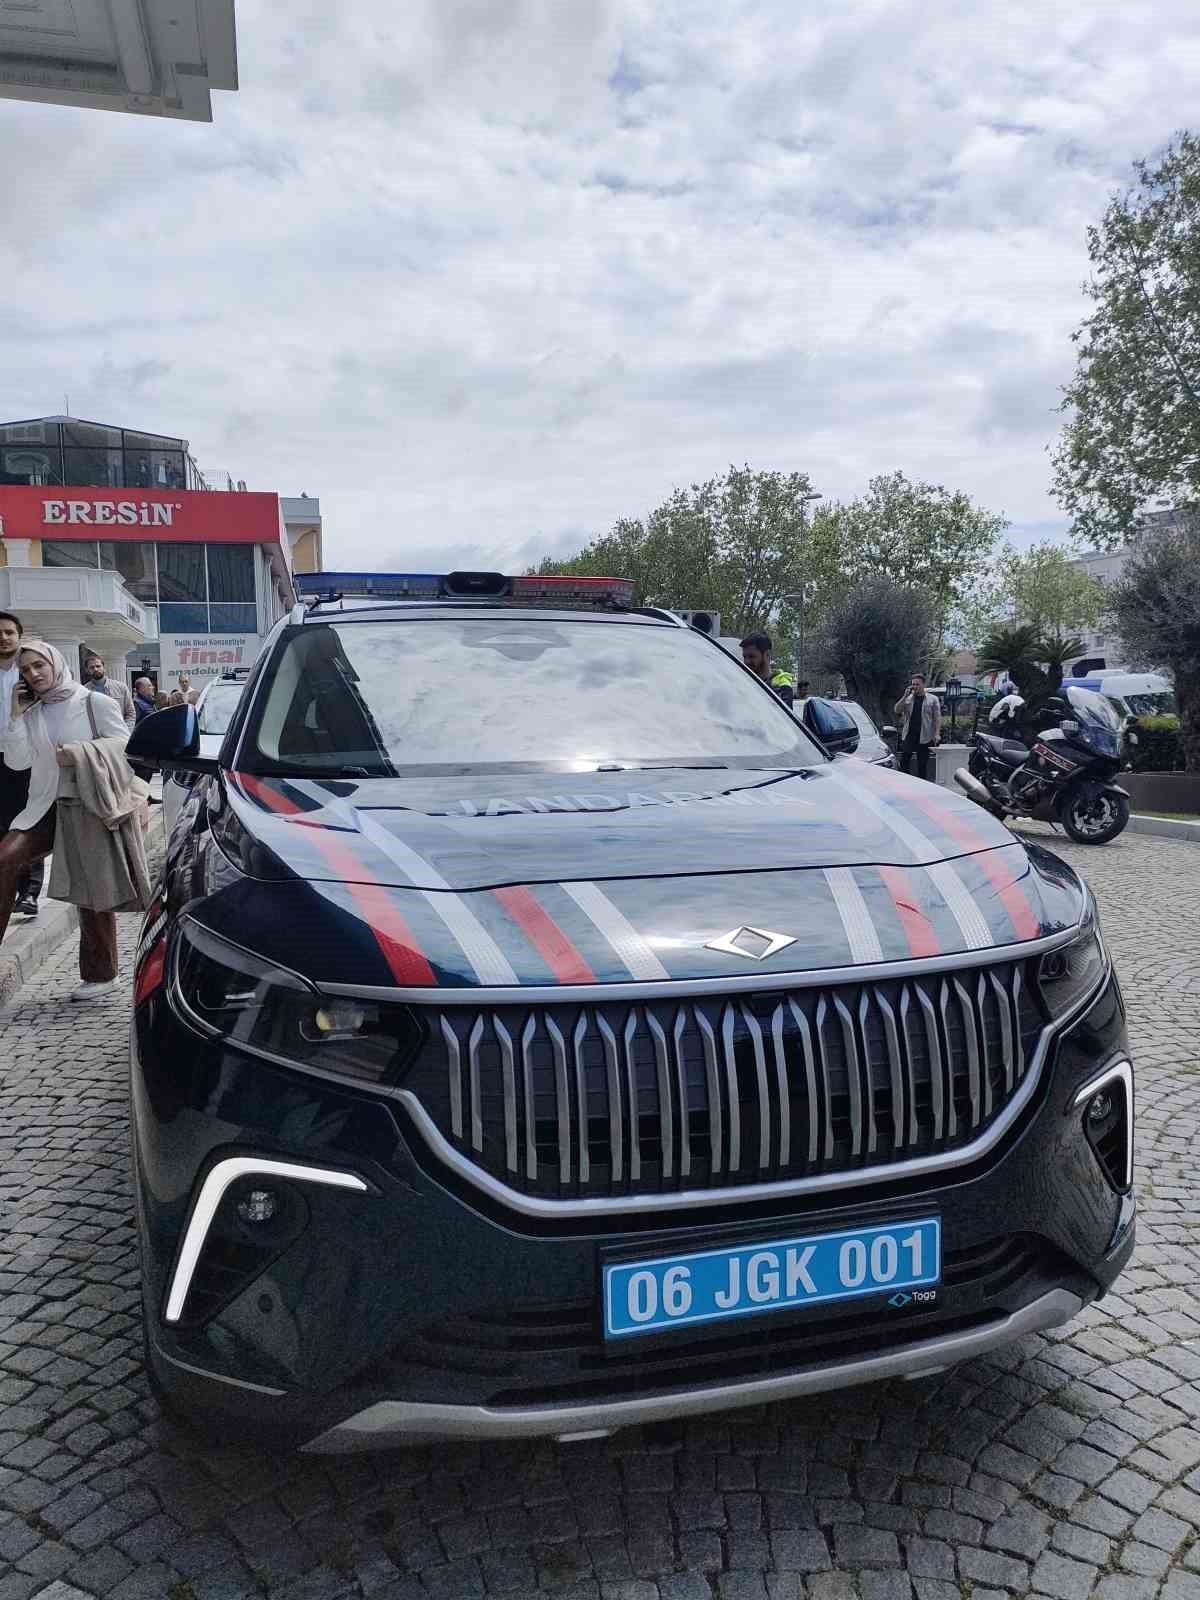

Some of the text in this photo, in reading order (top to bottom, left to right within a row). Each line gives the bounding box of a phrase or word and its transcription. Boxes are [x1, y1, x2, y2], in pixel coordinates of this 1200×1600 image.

[177, 647, 243, 665] final
[167, 667, 219, 677] anadolu
[627, 1229, 923, 1322] 06 JGK 001
[911, 1289, 936, 1302] Togg
